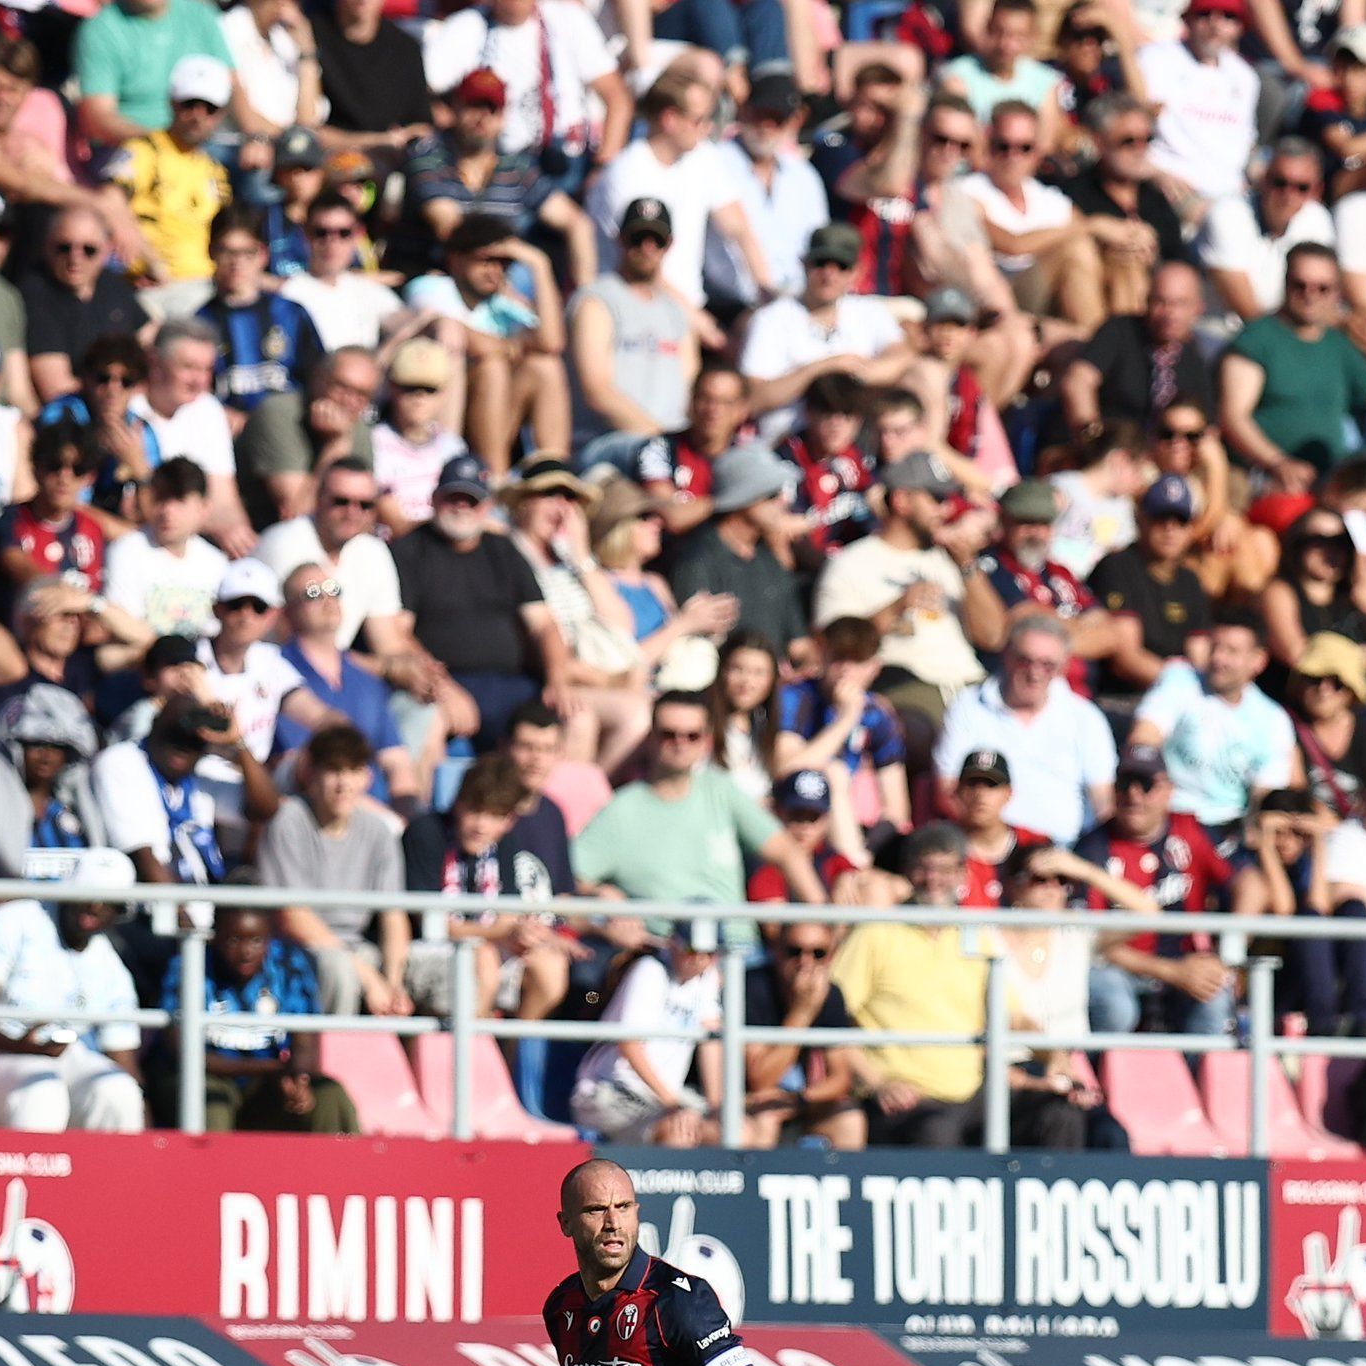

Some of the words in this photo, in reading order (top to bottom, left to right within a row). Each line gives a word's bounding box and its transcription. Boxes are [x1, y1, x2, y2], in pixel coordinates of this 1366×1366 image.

[219, 1191, 484, 1323] RIMINI
[757, 1174, 854, 1304] TRE
[861, 1175, 1004, 1306] TORRI
[1014, 1177, 1260, 1309] ROSSOBLU
